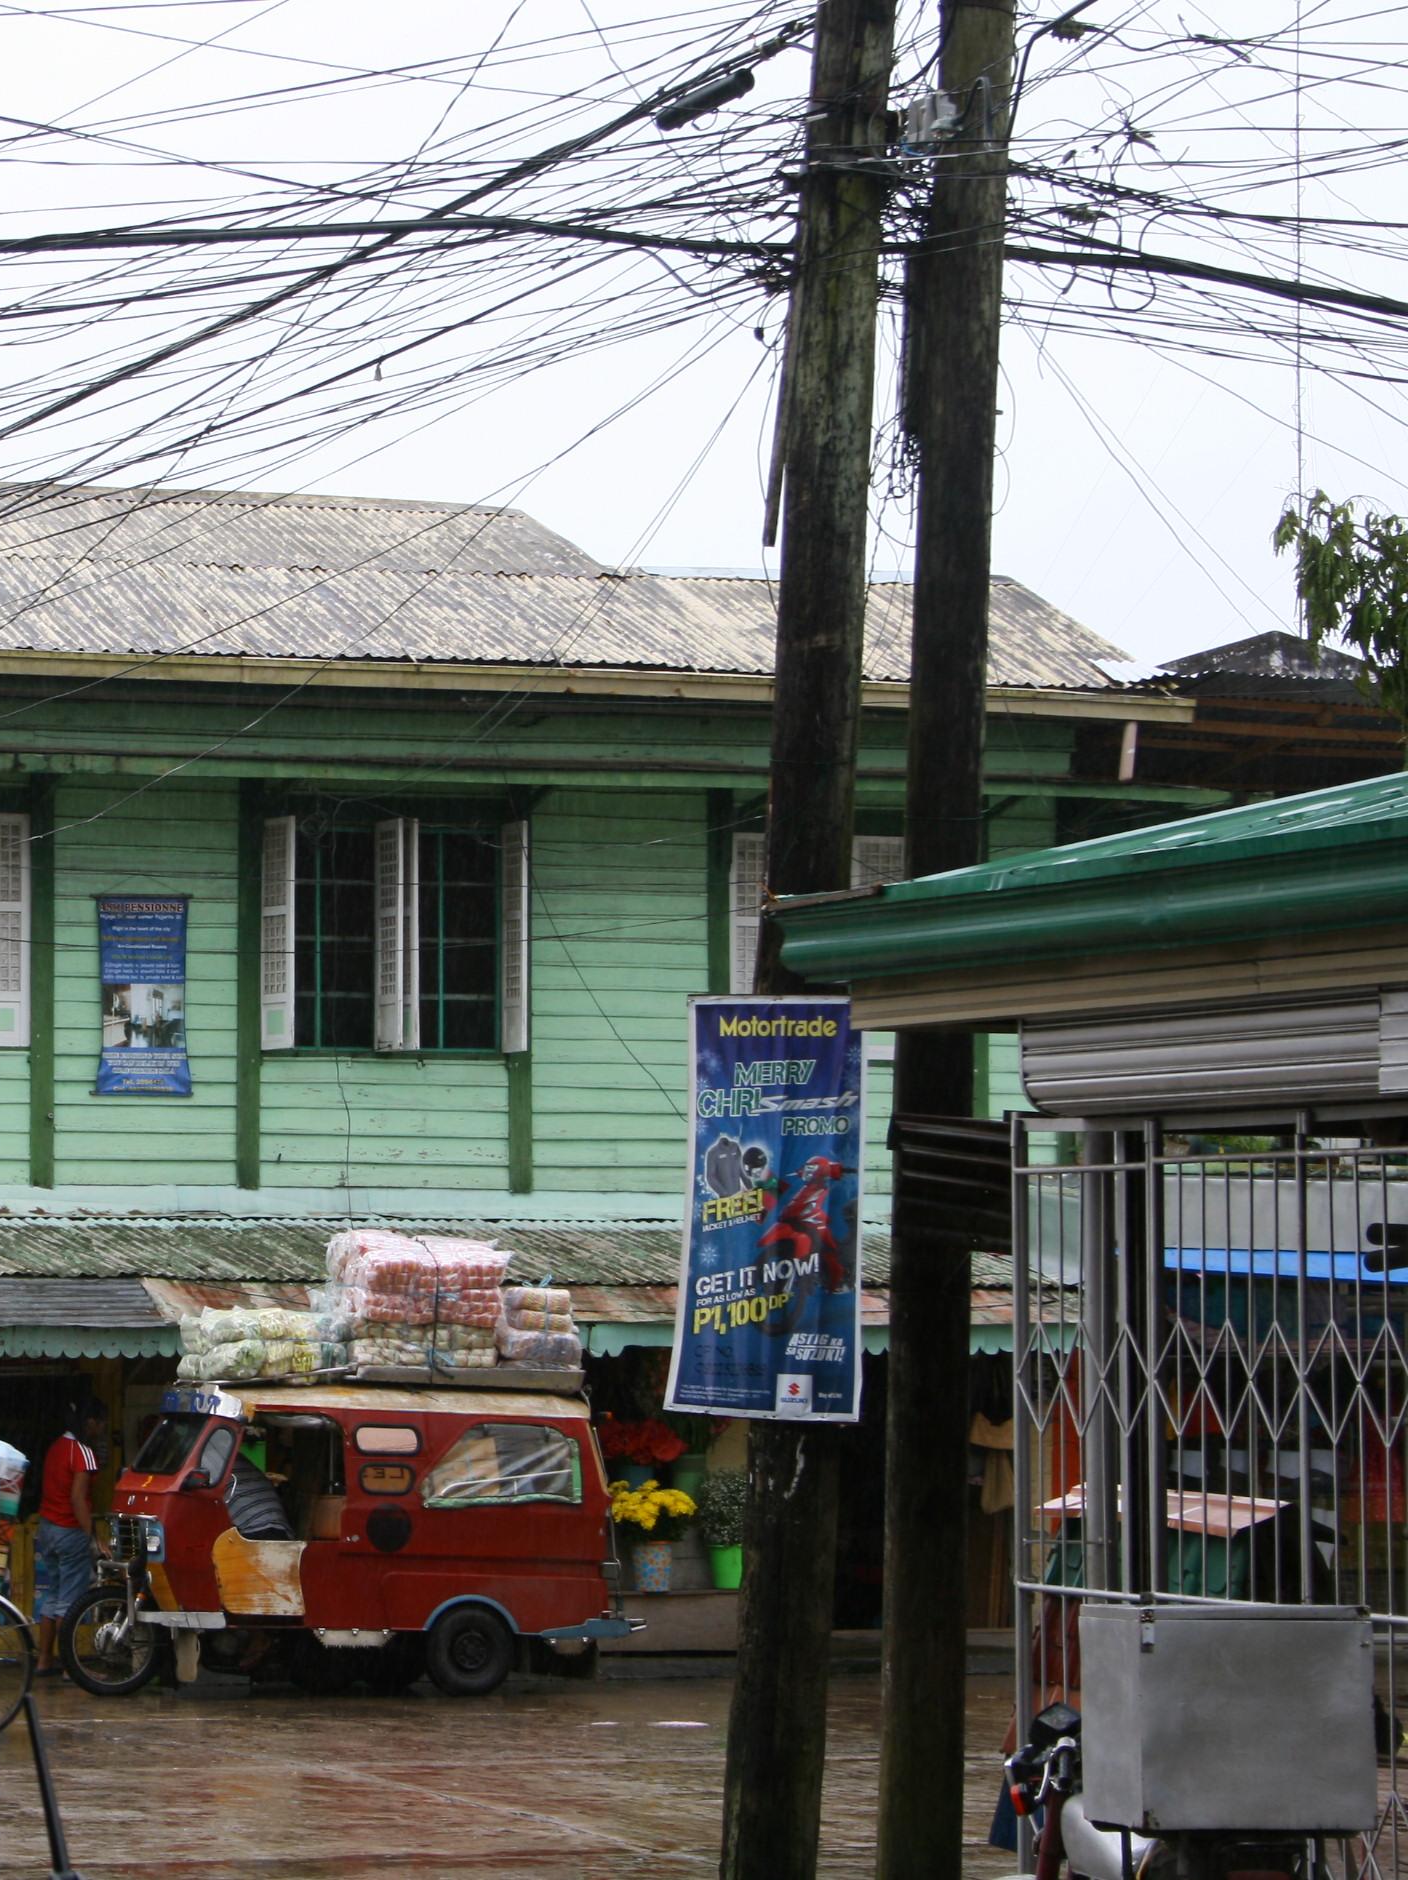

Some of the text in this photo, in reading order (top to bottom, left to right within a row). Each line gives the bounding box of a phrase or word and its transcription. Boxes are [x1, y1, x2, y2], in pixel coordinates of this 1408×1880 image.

[719, 1015, 837, 1037] Motortrade
[733, 1059, 816, 1086] MERRY
[781, 1116, 850, 1136] PROMO
[702, 1188, 765, 1224] FREE!
[695, 1253, 820, 1296] GET IT NOW!
[696, 1288, 756, 1307] FOR AS LOW AS
[693, 1297, 768, 1335] P1,100
[789, 1333, 830, 1347] ASTIG
[795, 1346, 845, 1362] SUZUKI!
